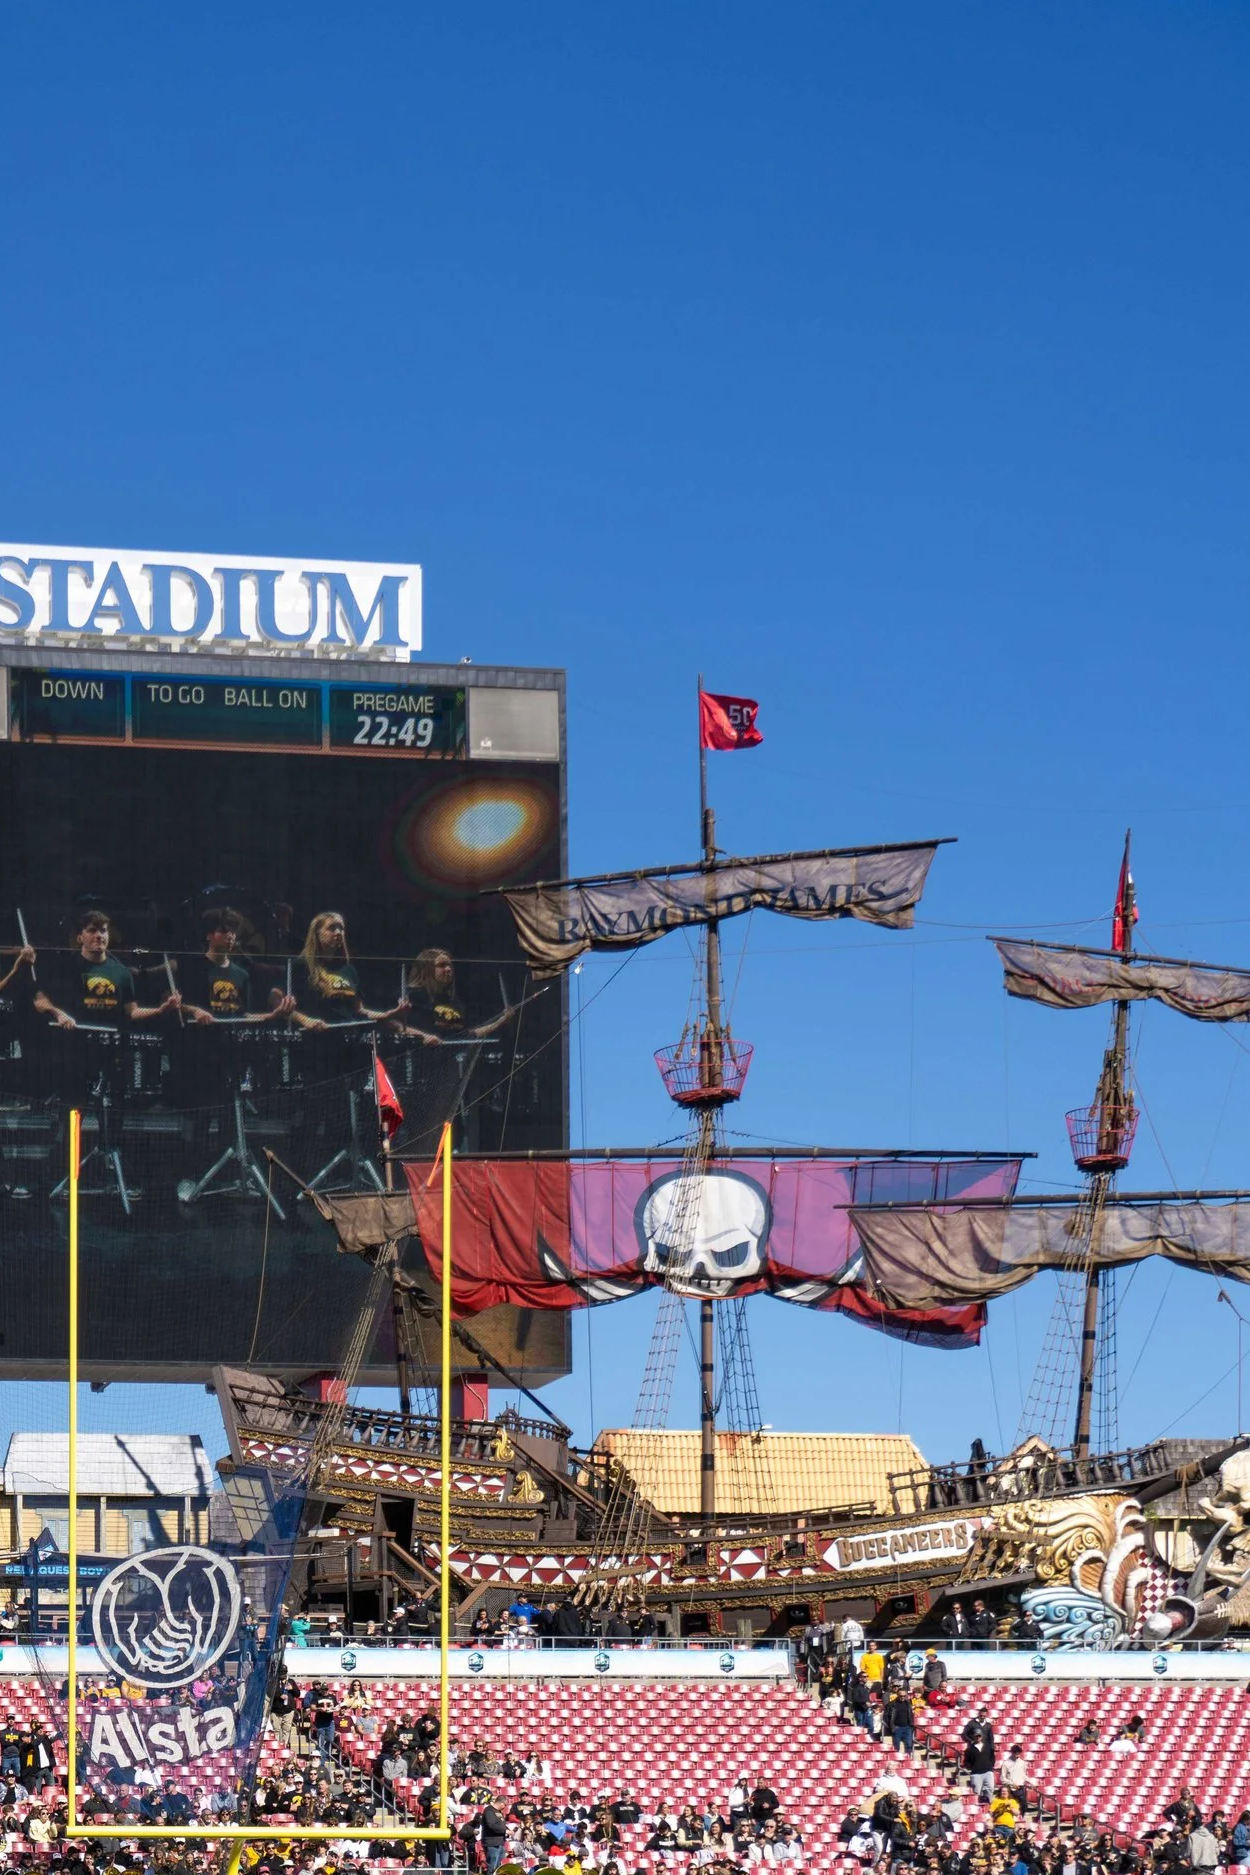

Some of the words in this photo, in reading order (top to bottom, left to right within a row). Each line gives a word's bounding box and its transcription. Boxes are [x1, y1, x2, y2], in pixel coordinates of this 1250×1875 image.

[41, 680, 104, 700] DOWN
[147, 684, 172, 703] TO
[178, 686, 205, 705] GO
[224, 688, 274, 708] BALL
[279, 690, 307, 709] ON
[353, 693, 435, 713] PREGAME
[352, 716, 435, 748] 22:49
[836, 1521, 969, 1568] BUCCANEERS
